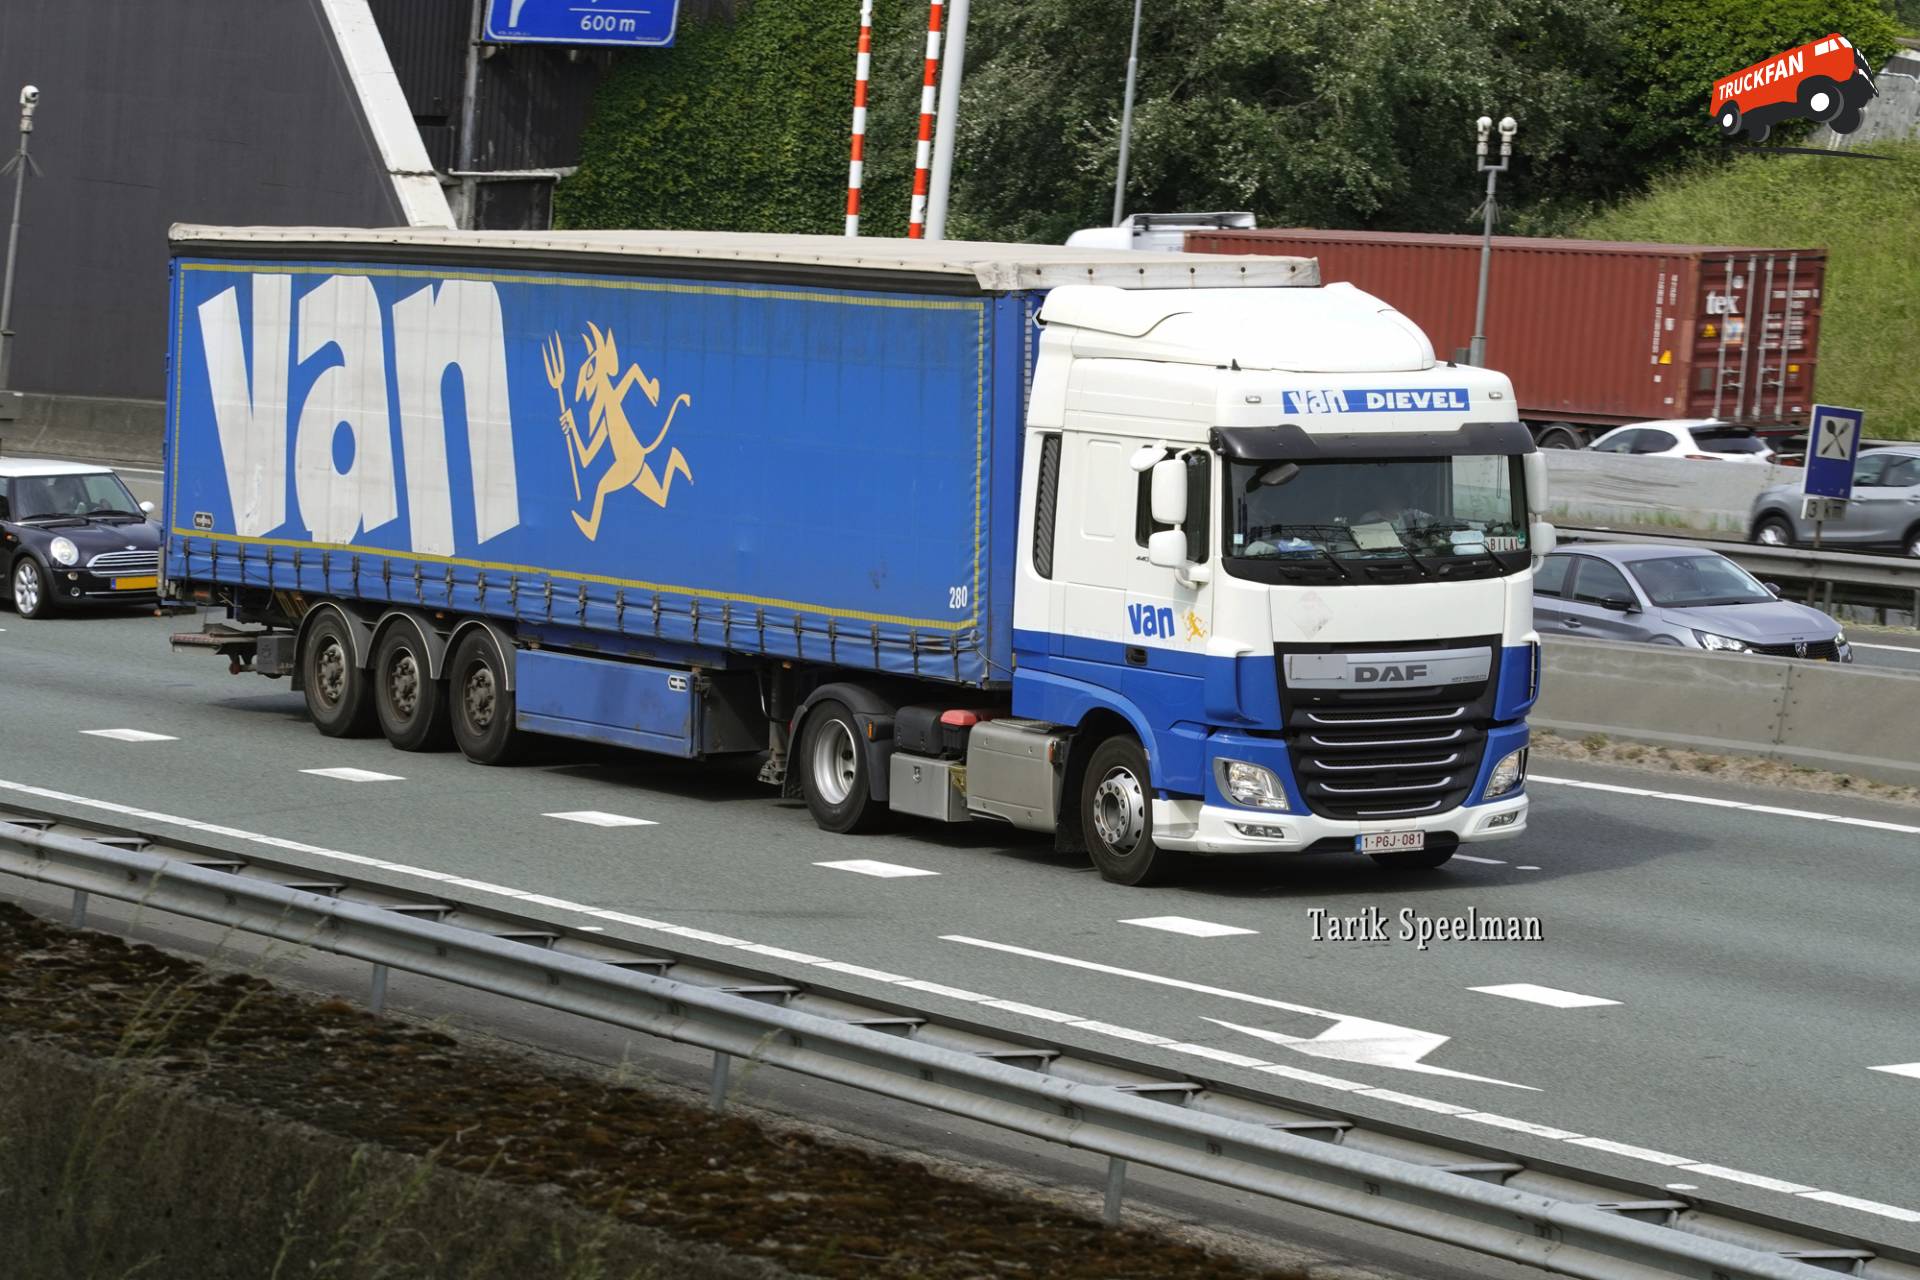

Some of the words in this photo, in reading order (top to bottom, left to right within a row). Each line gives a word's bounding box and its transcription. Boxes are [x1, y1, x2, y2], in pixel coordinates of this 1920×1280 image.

[580, 15, 616, 32] 600
[619, 18, 636, 32] m
[1366, 391, 1466, 410] DIEVEL
[1807, 501, 1817, 518] 3
[949, 585, 968, 609] 280
[1128, 603, 1175, 639] van
[1354, 665, 1427, 683] DAF
[1364, 833, 1422, 848] 1-PGJ-081
